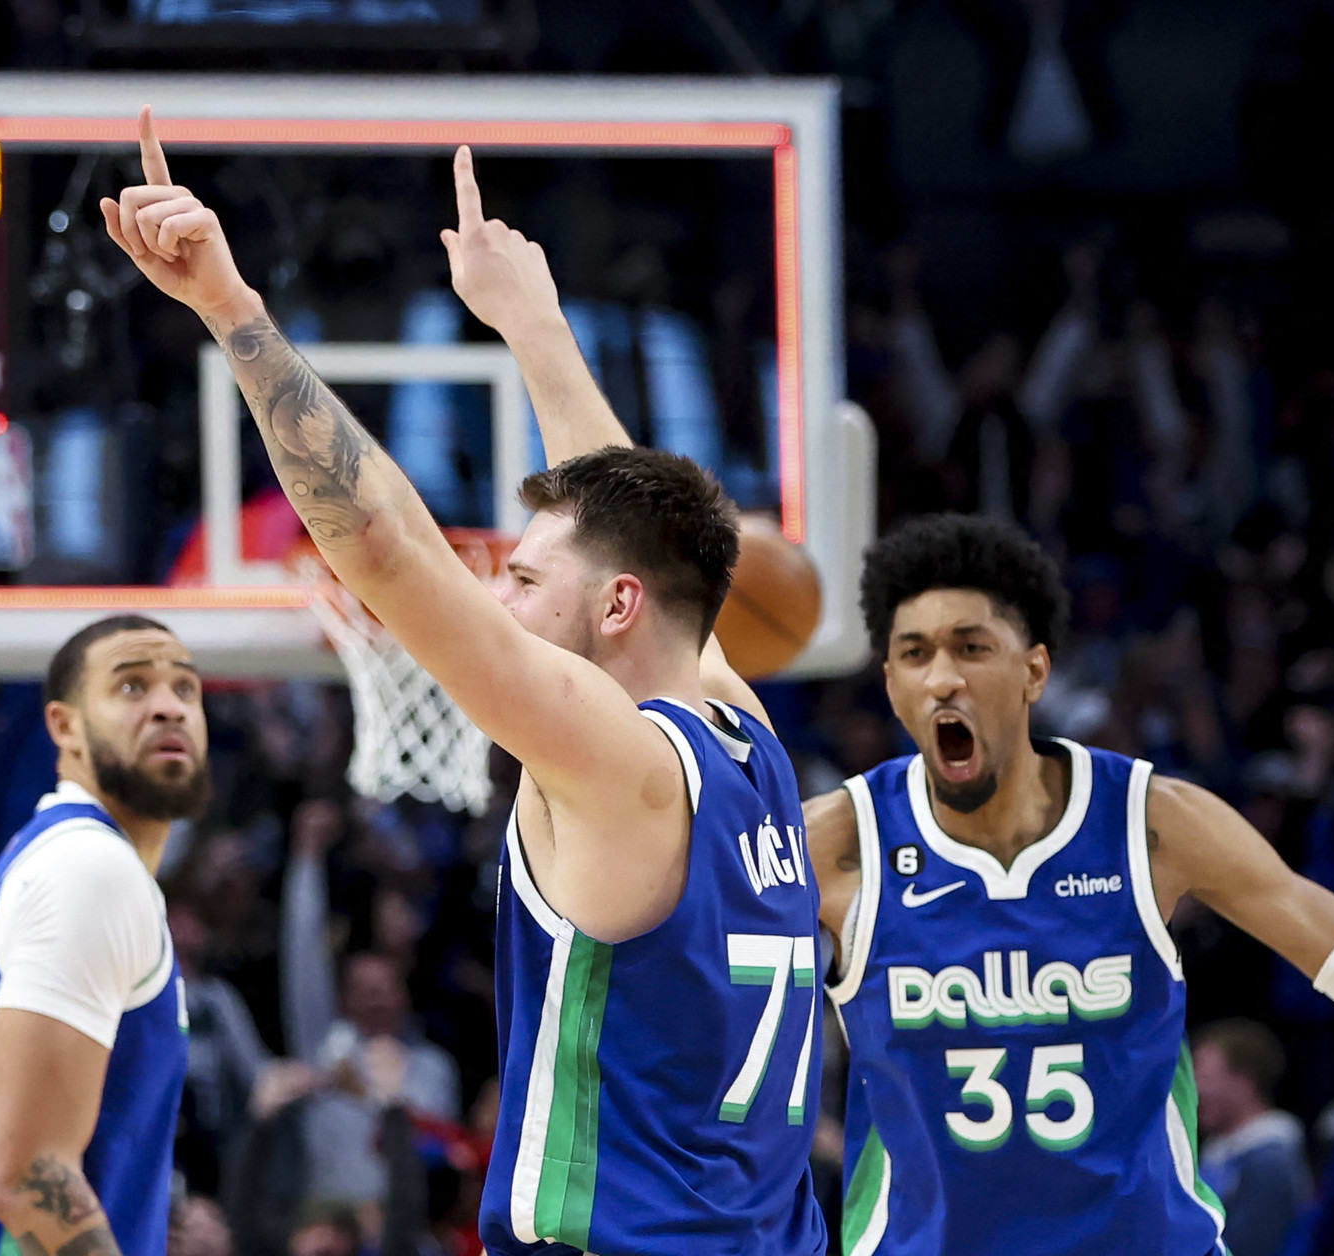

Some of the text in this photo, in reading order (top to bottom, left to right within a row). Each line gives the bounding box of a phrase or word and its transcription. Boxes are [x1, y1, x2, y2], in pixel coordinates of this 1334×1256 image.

[896, 846, 918, 875] 6
[1055, 872, 1123, 898] chime
[718, 932, 816, 1125] 77
[887, 950, 1133, 1030] Dallas
[944, 1042, 1096, 1152] 35
